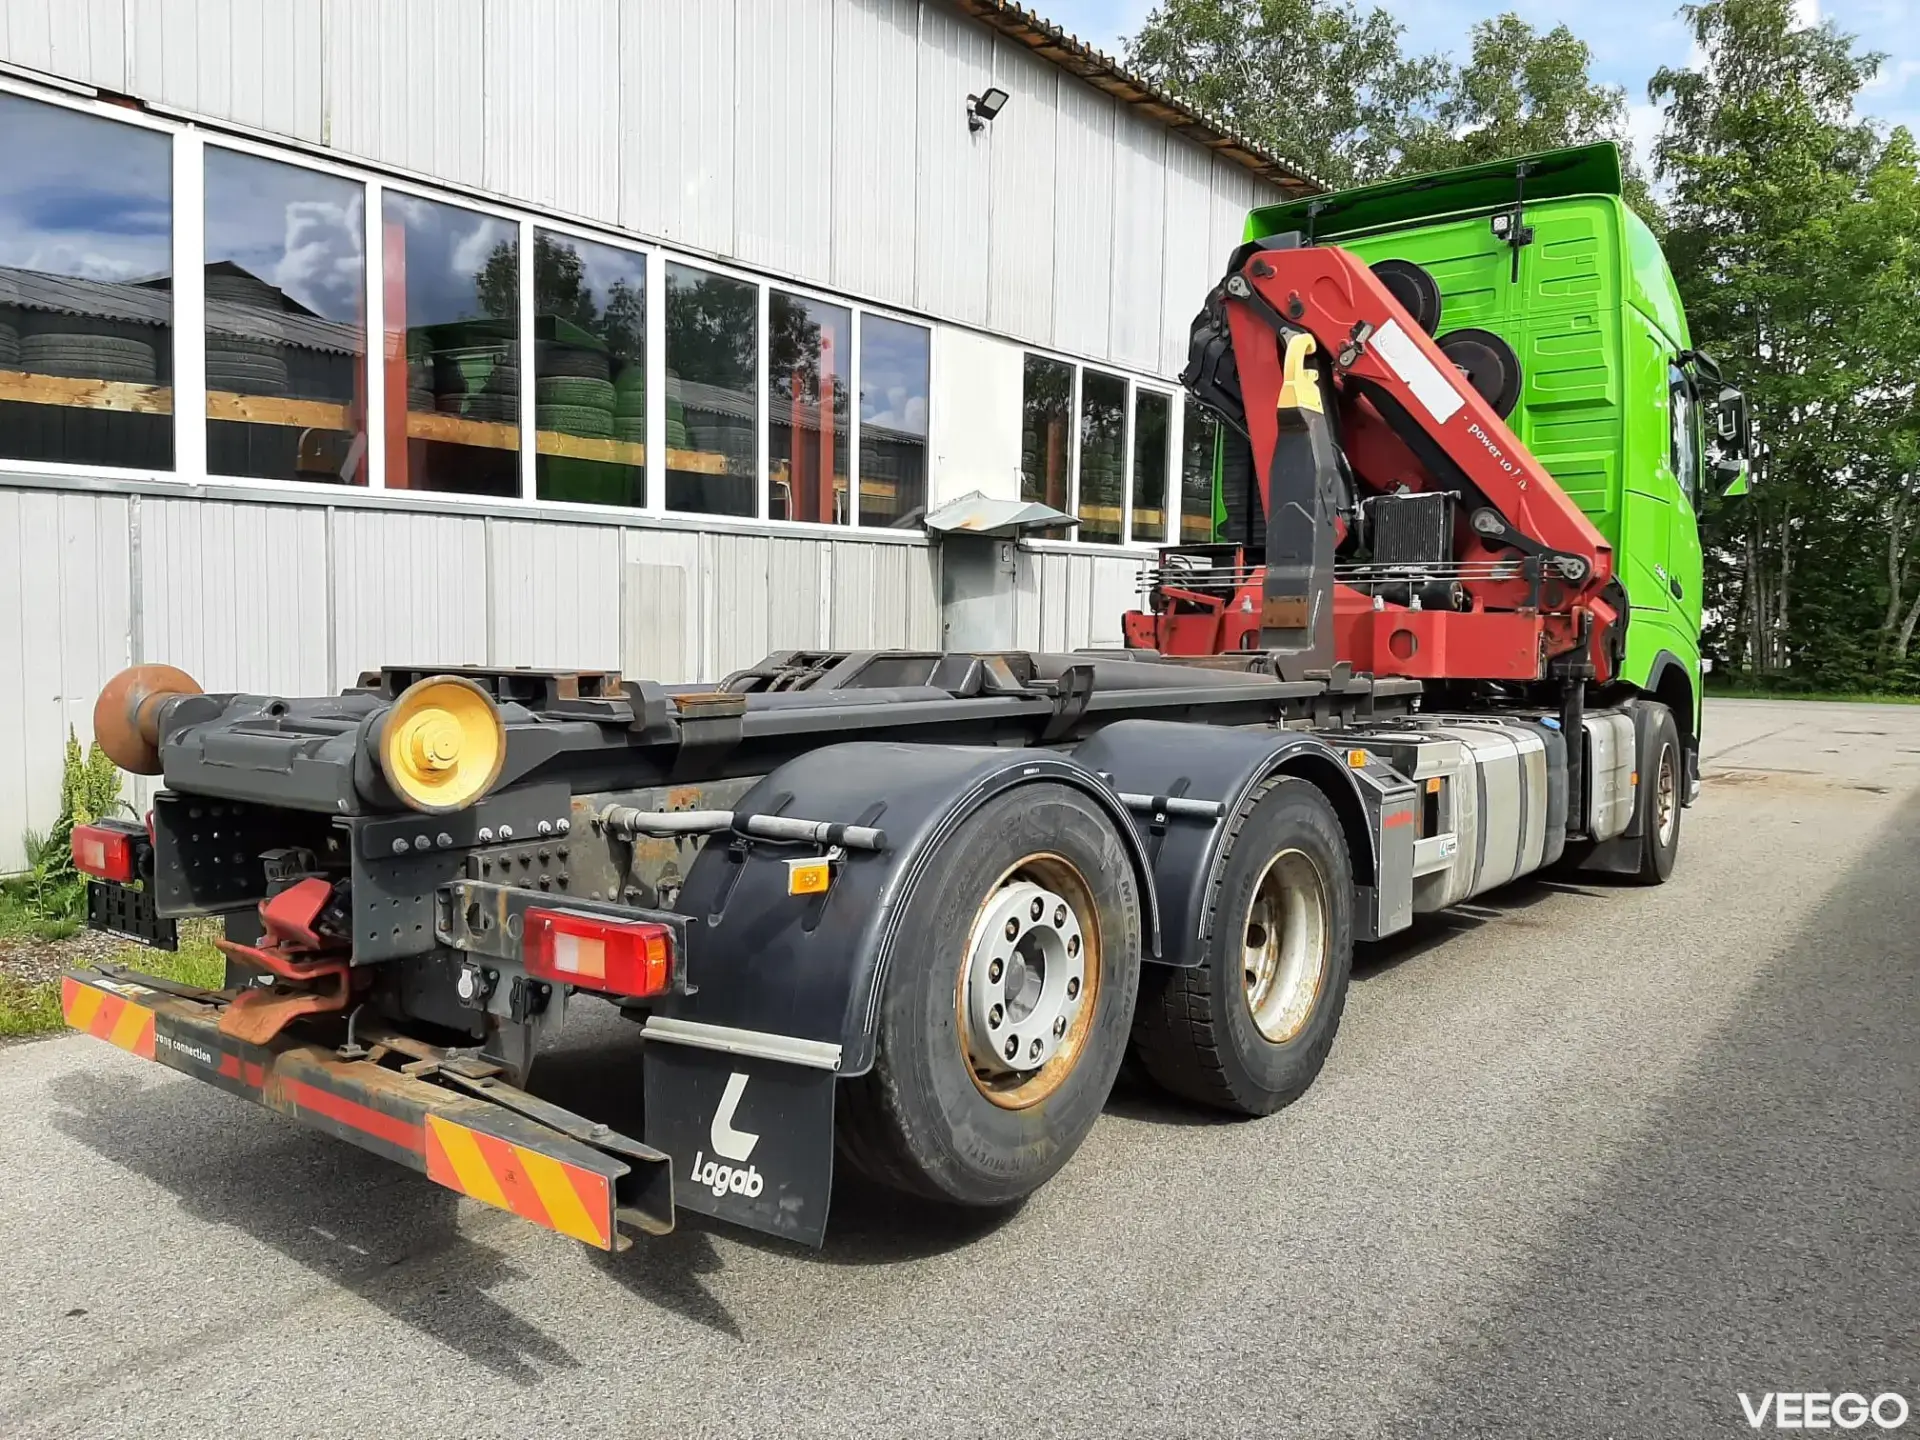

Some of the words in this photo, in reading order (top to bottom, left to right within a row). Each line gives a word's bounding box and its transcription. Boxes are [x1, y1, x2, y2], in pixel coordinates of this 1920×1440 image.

[1467, 423, 1502, 458] power
[1121, 880, 1136, 1018] MICHELIN
[155, 1033, 172, 1050] rong
[172, 1040, 212, 1064] connection
[690, 1150, 764, 1198] Lagab
